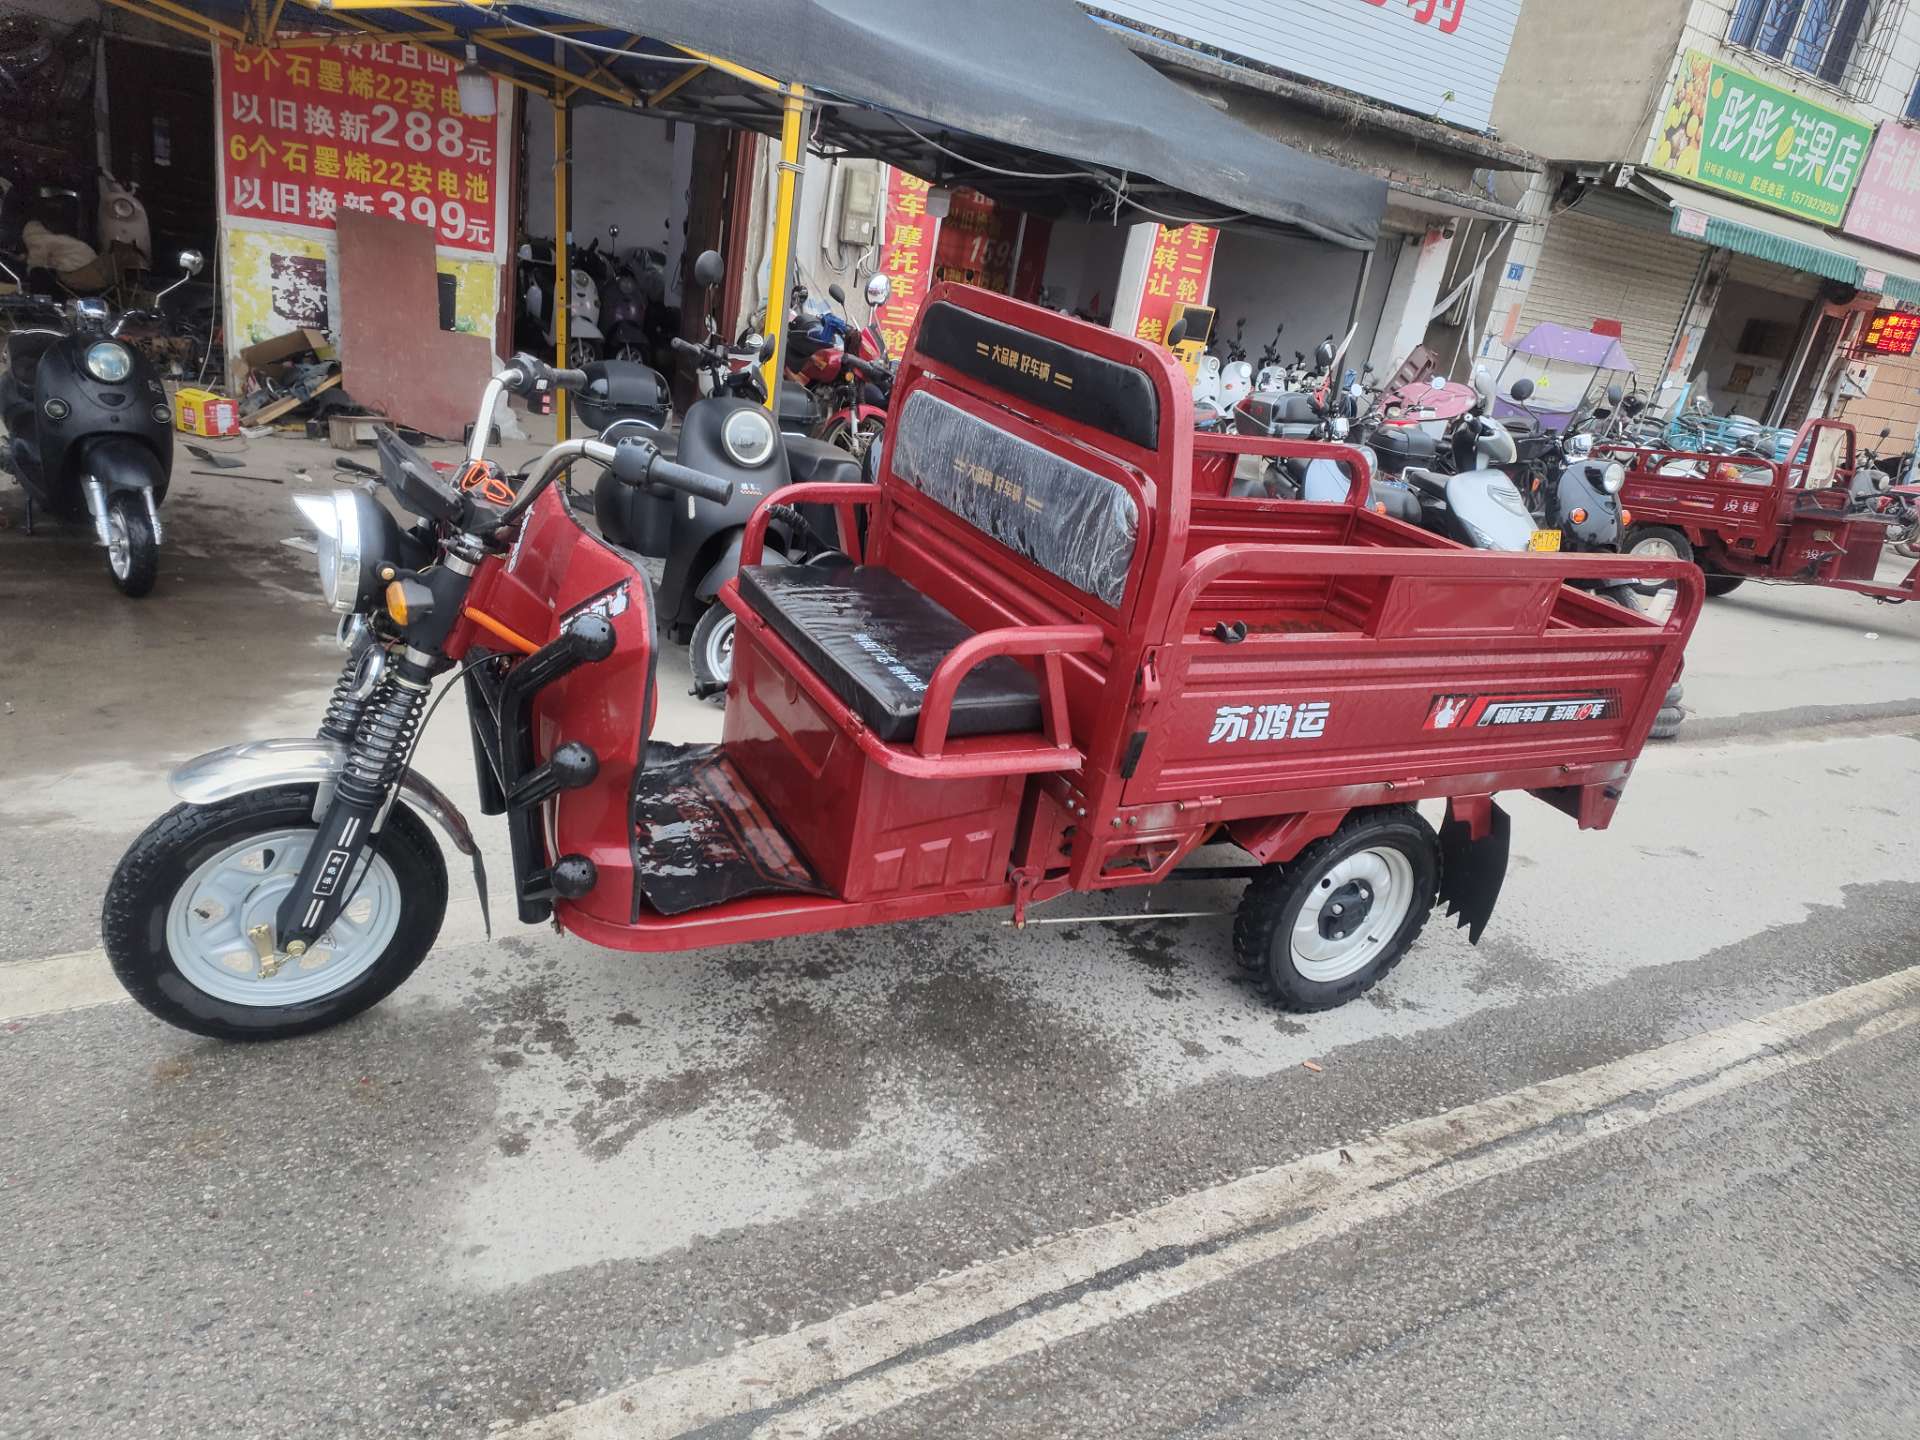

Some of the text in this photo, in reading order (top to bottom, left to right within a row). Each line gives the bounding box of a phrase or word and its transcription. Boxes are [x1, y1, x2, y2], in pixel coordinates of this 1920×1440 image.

[231, 91, 492, 166] 以旧换新288元
[229, 134, 489, 203] 6个石墨烯22安电池
[991, 344, 1051, 382] 大品牌 好车辆
[1208, 702, 1330, 743] 苏鸿运
